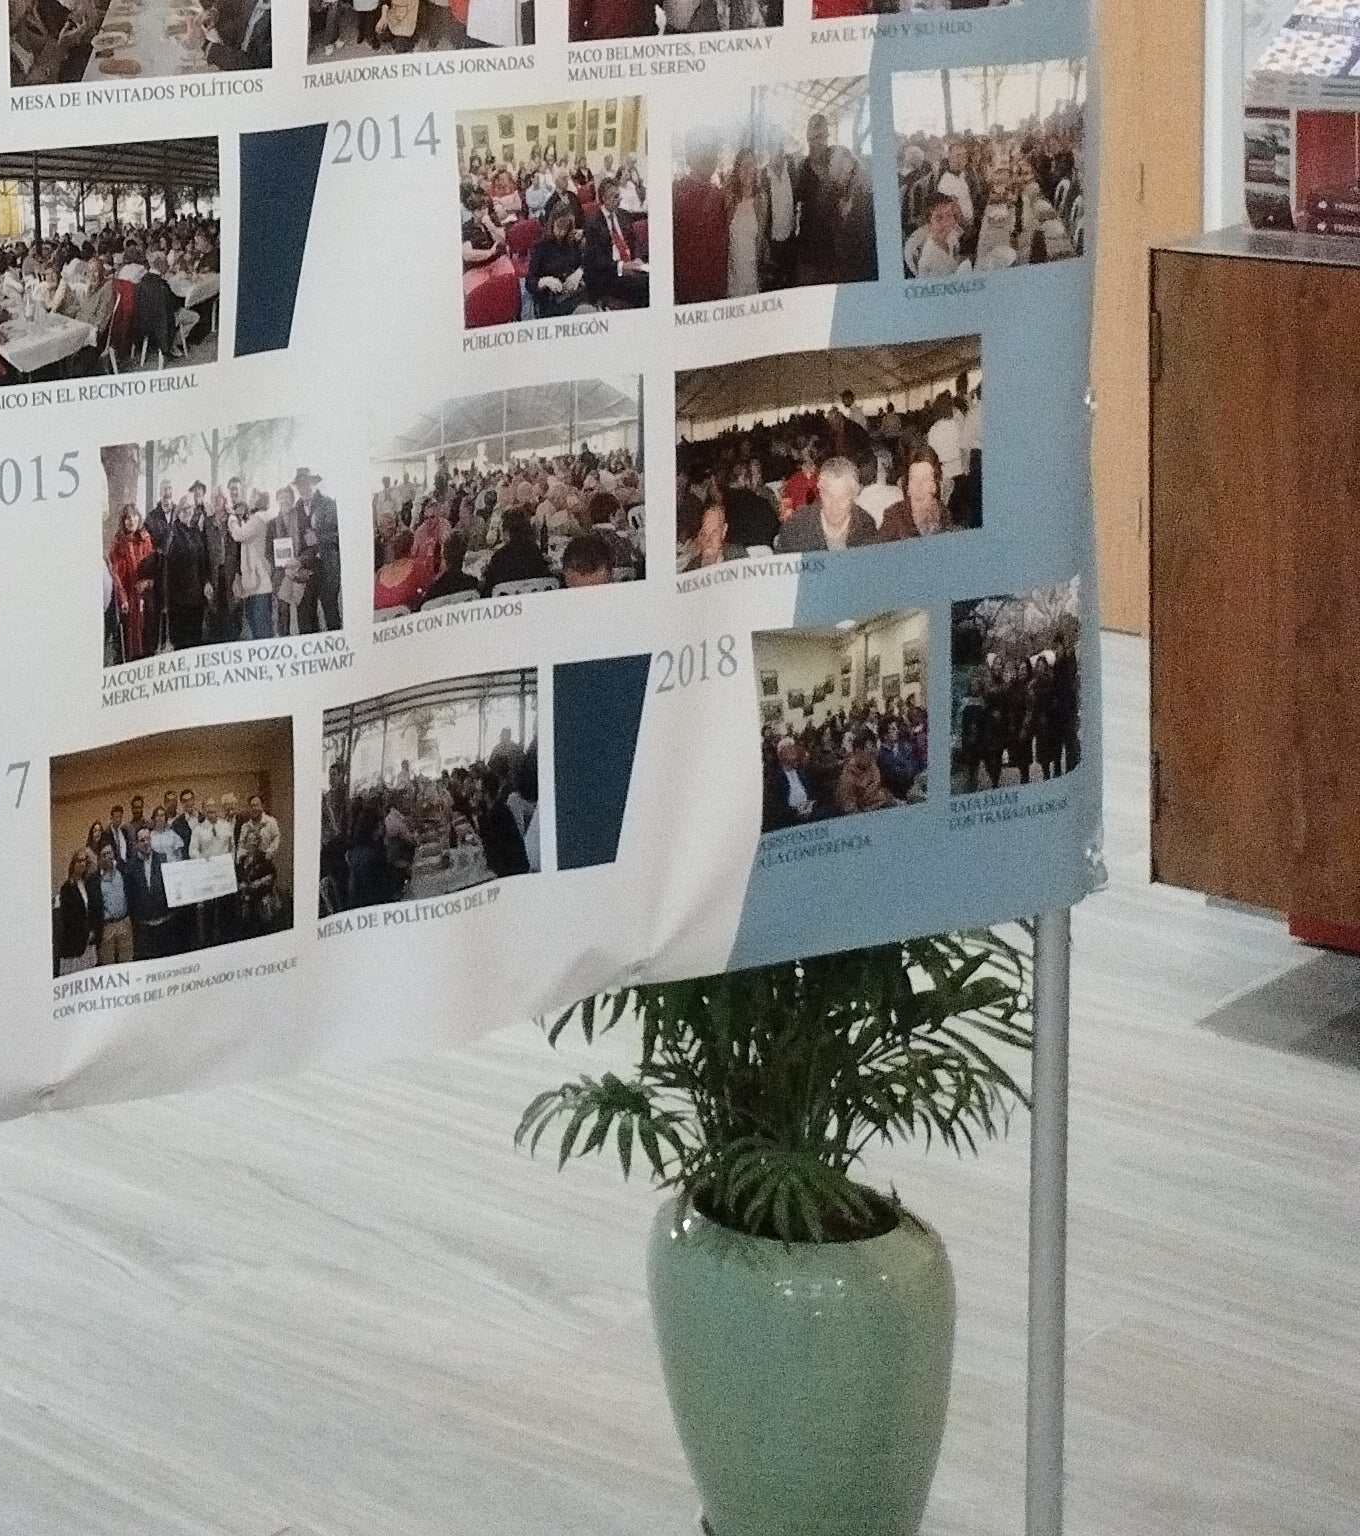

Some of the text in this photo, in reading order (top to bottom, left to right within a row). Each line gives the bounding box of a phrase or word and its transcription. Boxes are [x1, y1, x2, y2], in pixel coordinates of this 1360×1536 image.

[11, 79, 263, 112] MESA DE INVITADOS POLÍTICOS
[332, 112, 441, 165] 2014
[517, 328, 533, 343] EN
[31, 391, 51, 406] EN
[57, 388, 75, 403] EL
[79, 380, 146, 400] RECINTO
[149, 373, 198, 393] FERIAL
[373, 601, 522, 644] MESAS CON INVITADOS
[655, 634, 738, 695] 2018
